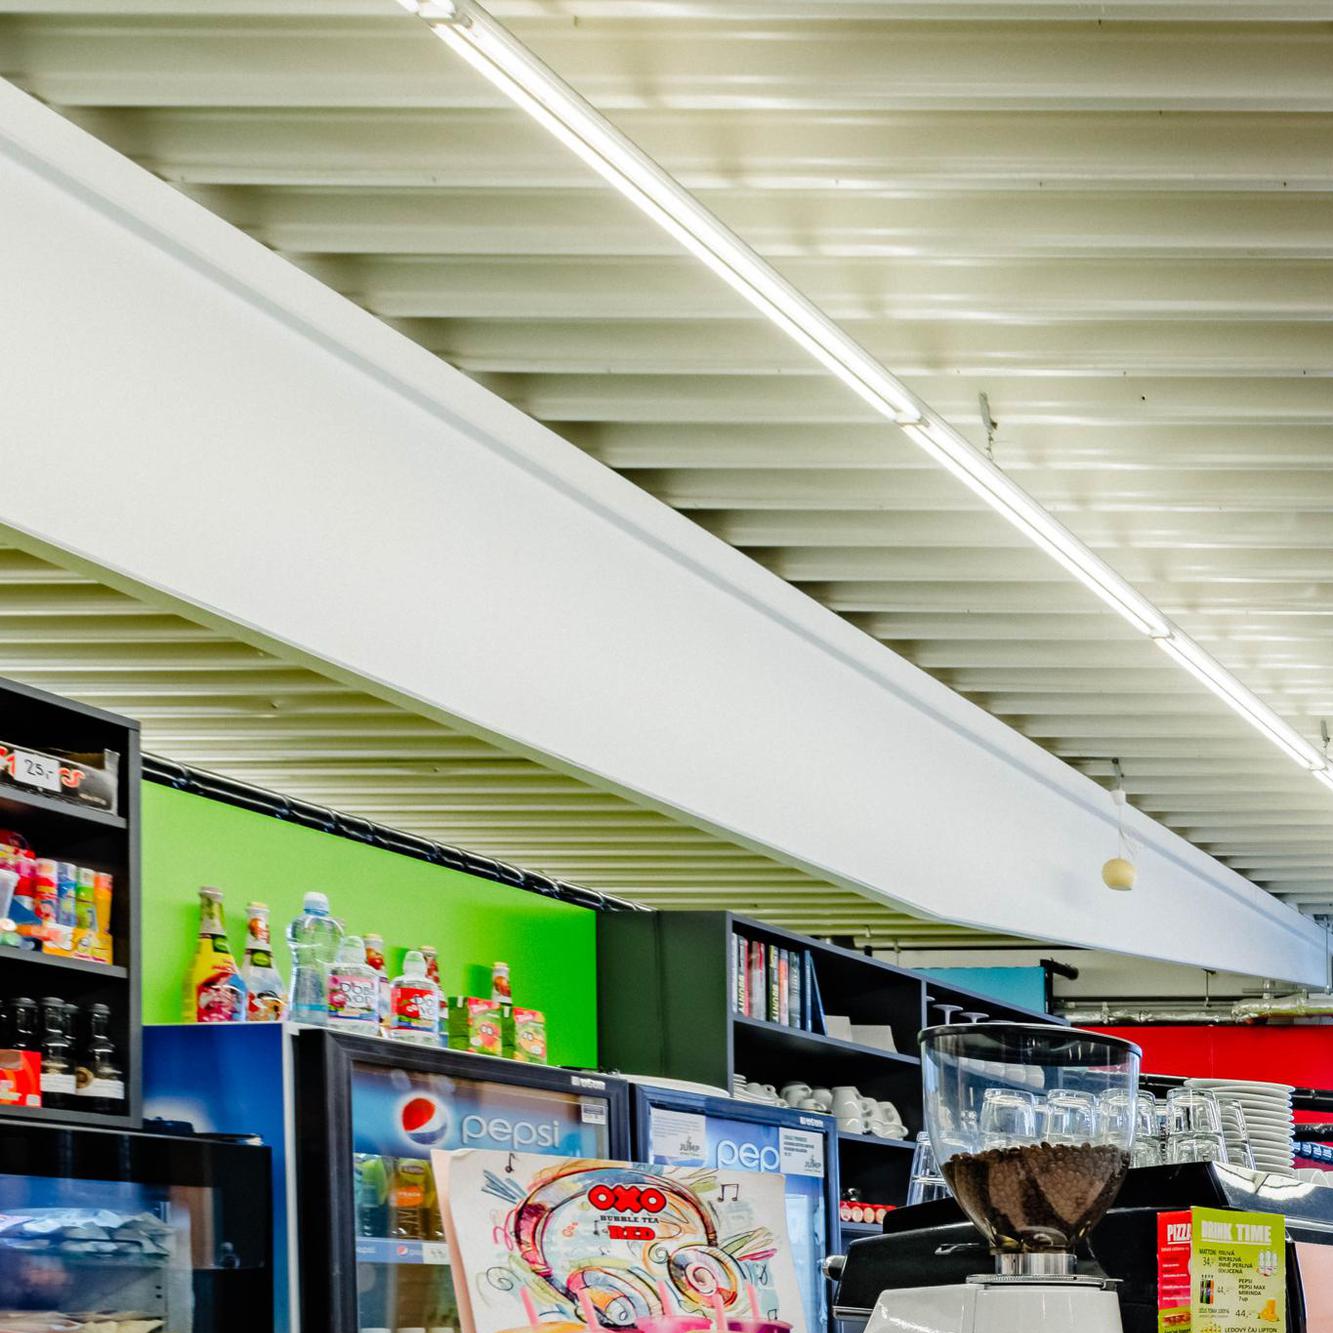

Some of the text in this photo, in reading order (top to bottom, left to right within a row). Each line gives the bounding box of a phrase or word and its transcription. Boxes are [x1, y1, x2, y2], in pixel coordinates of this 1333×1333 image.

[460, 1111, 560, 1150] pepsi
[717, 1139, 779, 1174] pep
[587, 1184, 667, 1214] OXO
[1235, 1223, 1272, 1243] TIME
